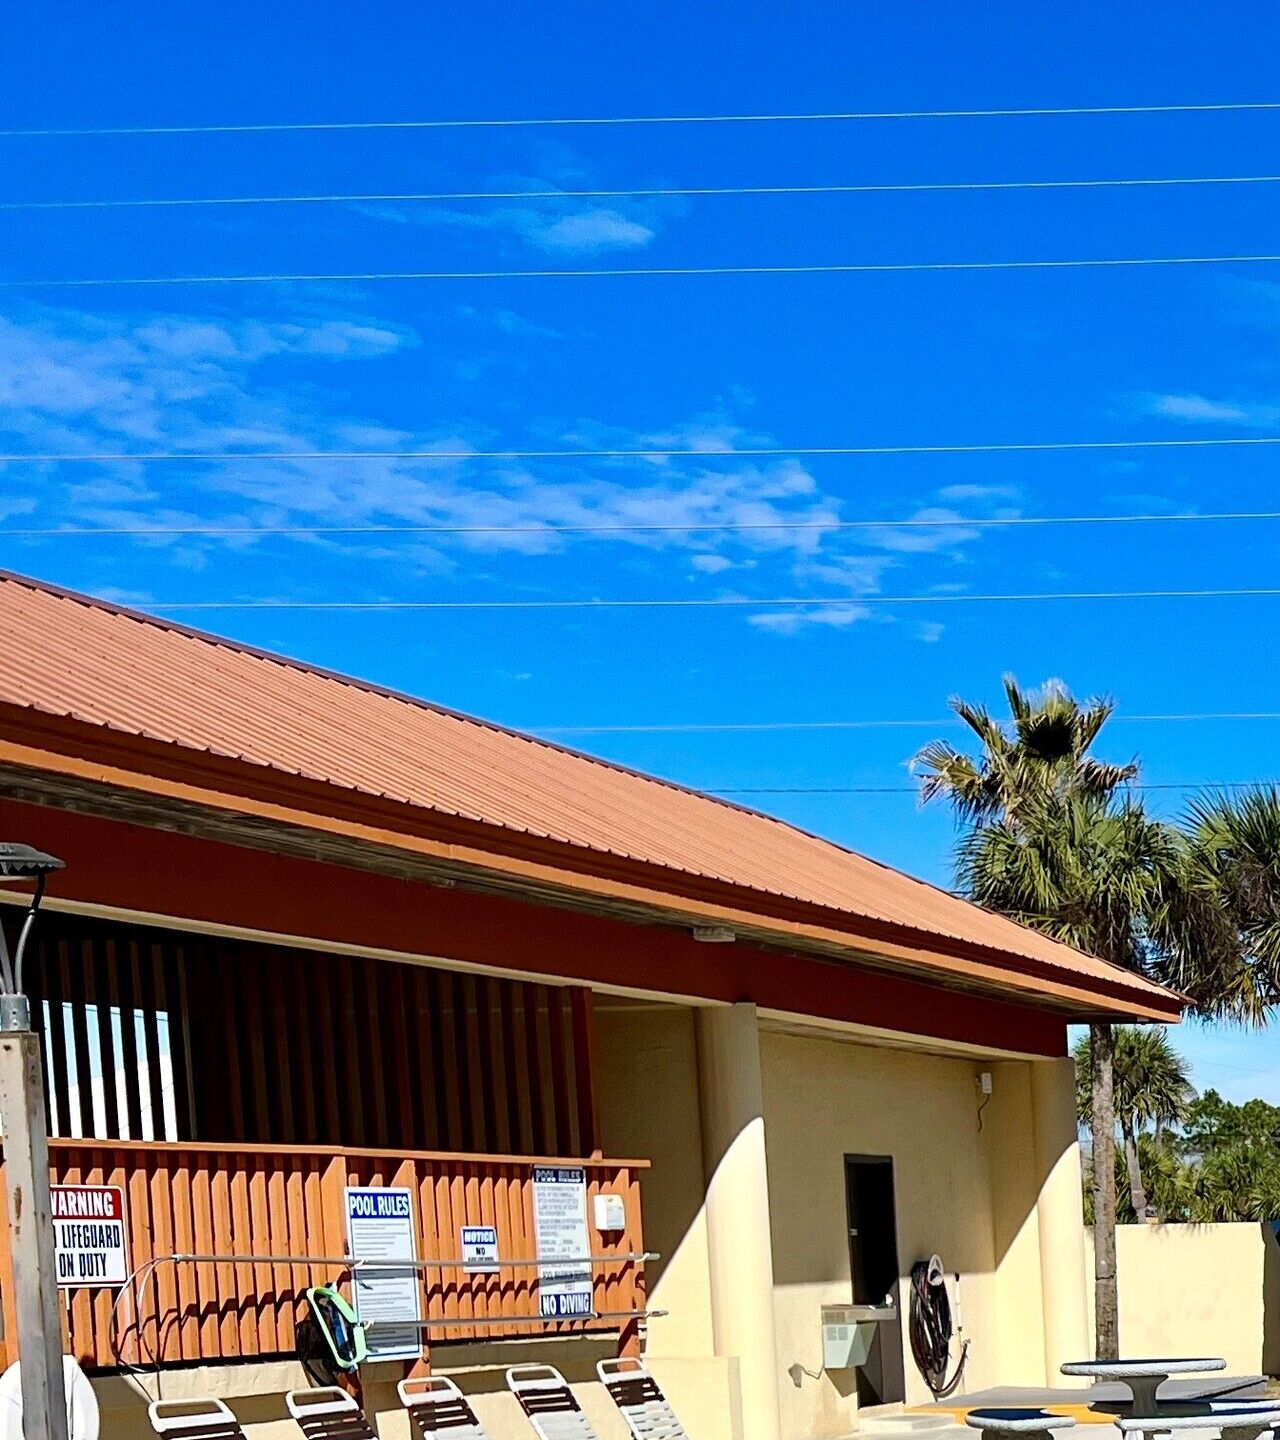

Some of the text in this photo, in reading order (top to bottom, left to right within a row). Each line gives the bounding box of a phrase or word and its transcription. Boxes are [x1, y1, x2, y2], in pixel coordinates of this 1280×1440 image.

[349, 1195, 409, 1216] POOL RULES
[61, 1224, 121, 1249] LIFEGUARD
[464, 1231, 494, 1243] NOTICE
[59, 1253, 107, 1277] ON DUTY
[542, 1293, 590, 1315] NO DIVING
